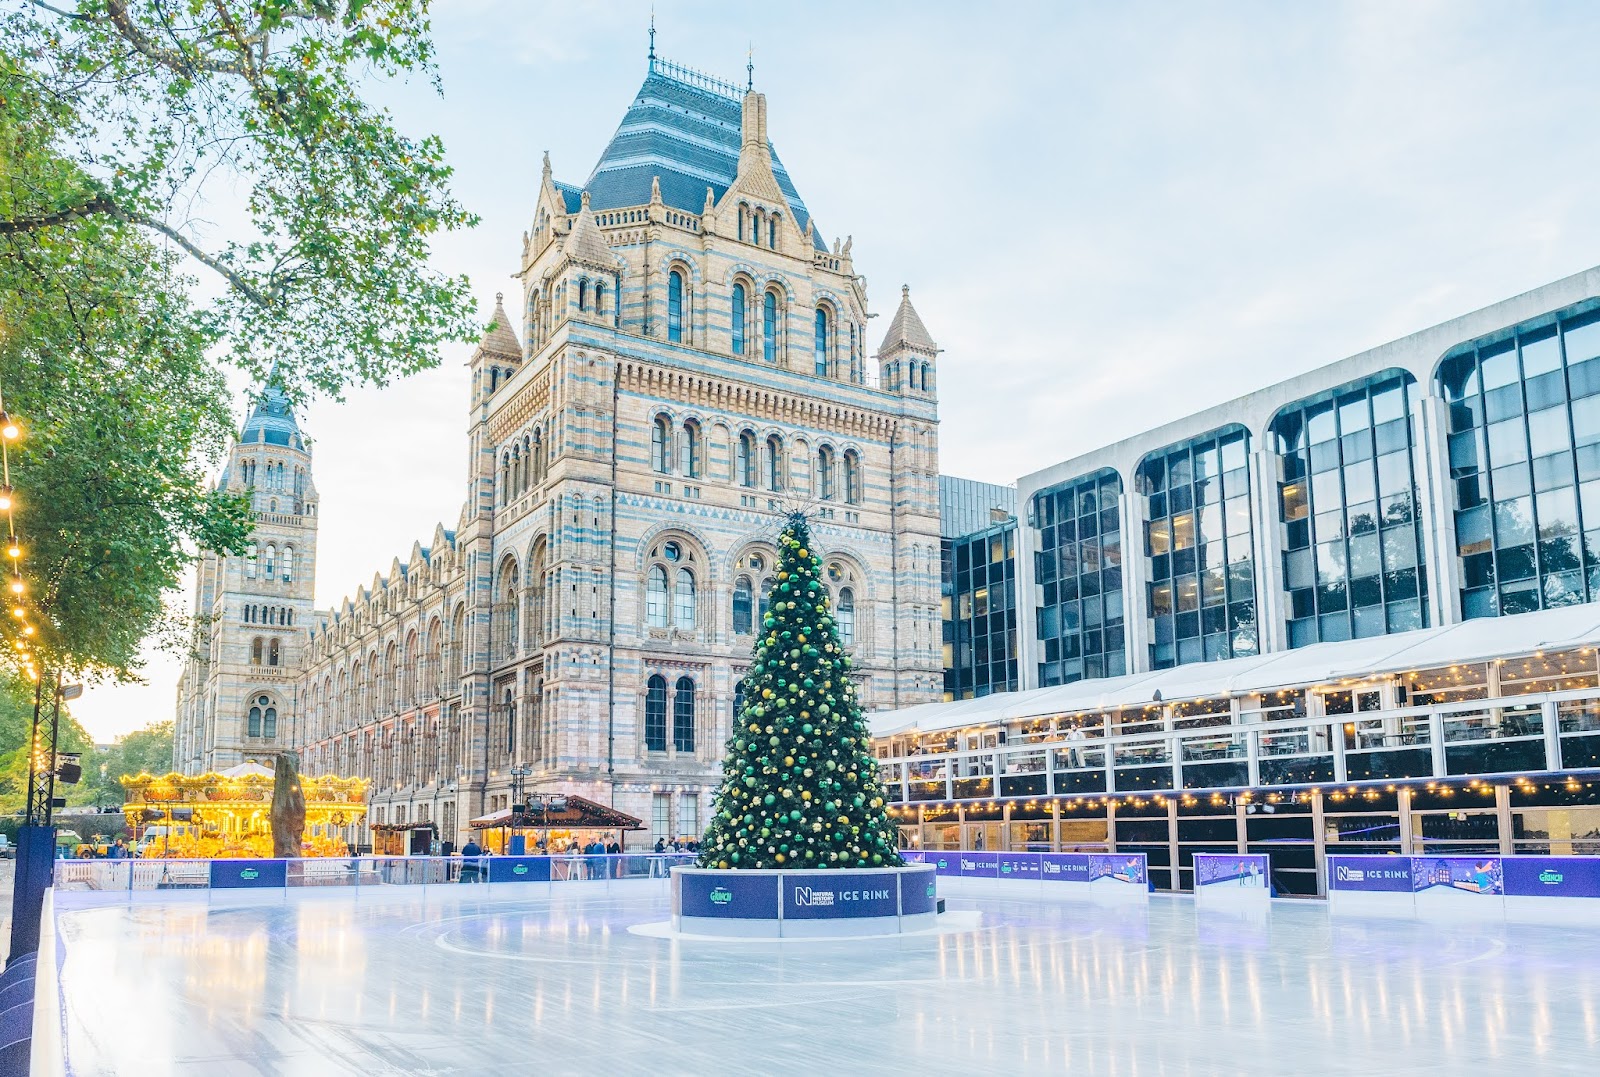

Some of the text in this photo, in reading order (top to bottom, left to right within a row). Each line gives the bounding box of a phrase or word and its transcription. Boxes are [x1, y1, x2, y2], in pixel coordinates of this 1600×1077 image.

[1337, 866, 1349, 881] N
[1366, 870, 1382, 878] ICE
[1384, 870, 1409, 879] RINK
[795, 886, 812, 906] N
[839, 889, 890, 901] ICE RINK
